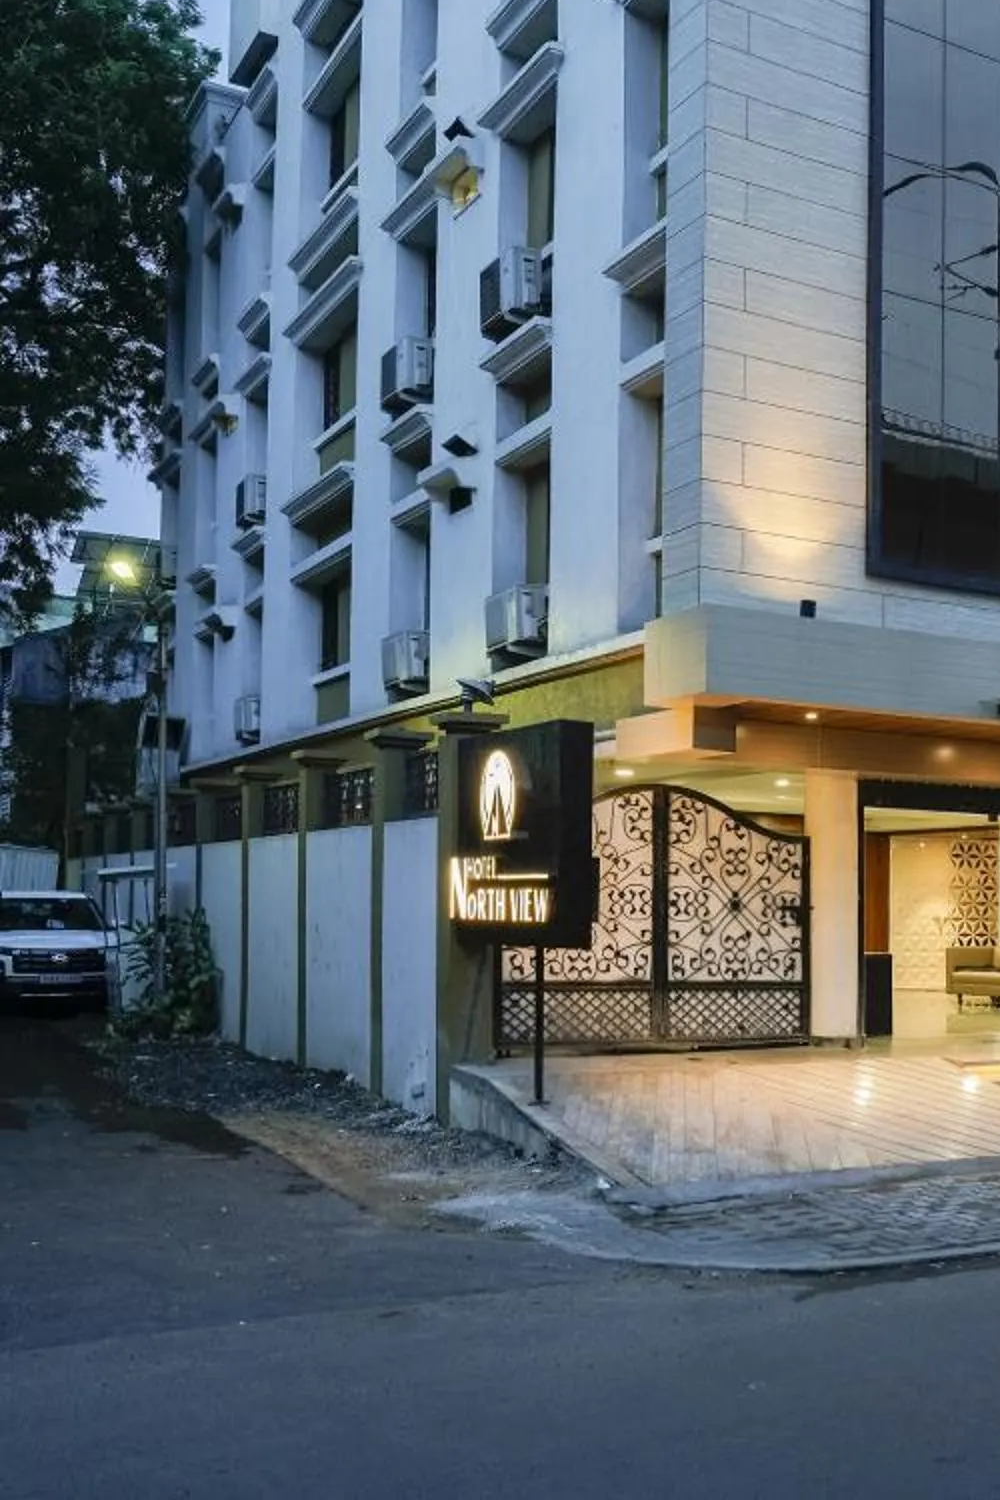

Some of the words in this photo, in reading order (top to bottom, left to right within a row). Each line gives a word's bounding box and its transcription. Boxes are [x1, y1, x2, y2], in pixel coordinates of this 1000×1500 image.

[449, 857, 505, 921] NORTH
[509, 887, 549, 922] VIEW
[464, 856, 497, 879] HOTEL
